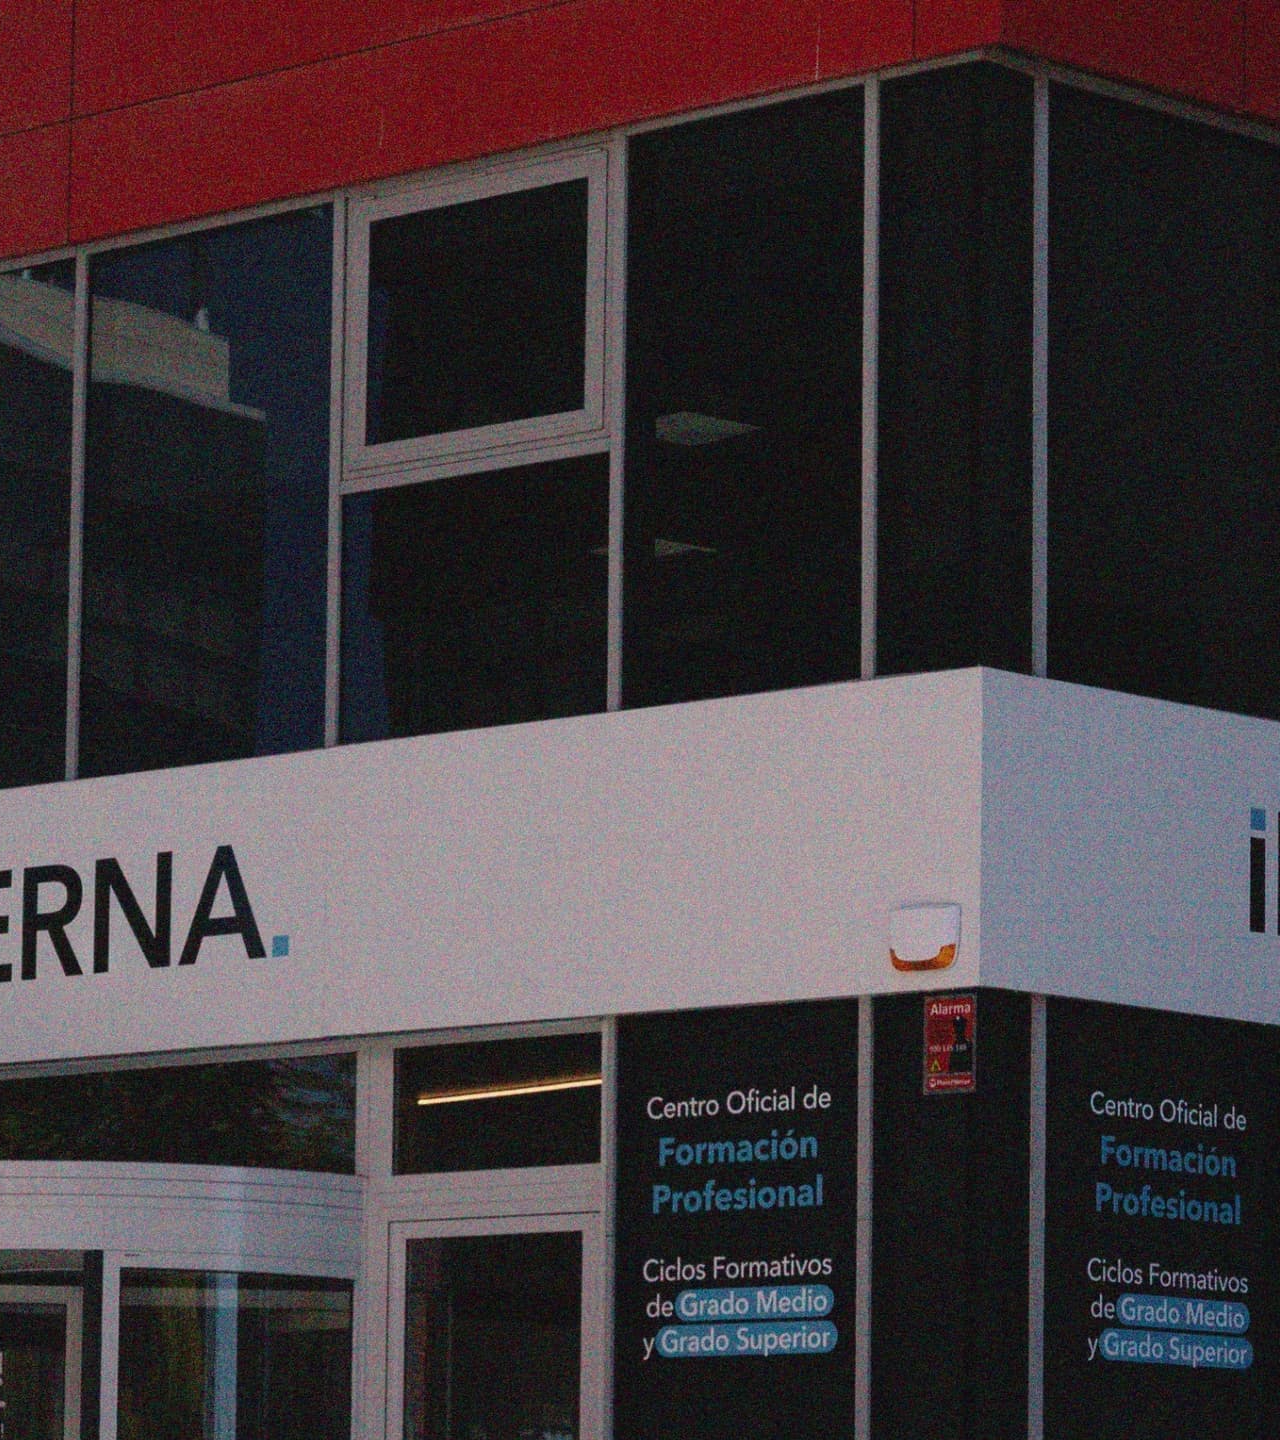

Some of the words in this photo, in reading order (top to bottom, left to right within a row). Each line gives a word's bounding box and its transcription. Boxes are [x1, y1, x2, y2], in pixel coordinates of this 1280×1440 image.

[930, 1002, 971, 1015] Alarma
[647, 1096, 719, 1120] Centro
[727, 1086, 795, 1114] Oficial
[803, 1085, 831, 1109] de
[1090, 1091, 1154, 1120] Centro
[1160, 1099, 1217, 1127] Oficial
[1223, 1105, 1247, 1130] de
[659, 1129, 818, 1166] Formación
[1101, 1135, 1237, 1177] Formación
[652, 1173, 824, 1214] Profesional
[1095, 1182, 1241, 1225] Profesional
[643, 1257, 706, 1282] Ciclos
[713, 1253, 832, 1279] Formativos
[1087, 1257, 1143, 1284] Ciclos
[1149, 1263, 1248, 1293] Formativos
[646, 1294, 673, 1317] de
[681, 1291, 749, 1317] Grado
[757, 1288, 828, 1313] Medio
[1091, 1293, 1115, 1319] de
[1121, 1297, 1180, 1323] Grado
[1186, 1302, 1245, 1328] Medio
[642, 1336, 655, 1360] y
[662, 1327, 730, 1353] Grado
[737, 1326, 831, 1357] Superior
[1087, 1337, 1098, 1361] y
[1104, 1332, 1164, 1358] Grado
[1170, 1337, 1247, 1368] Superior
